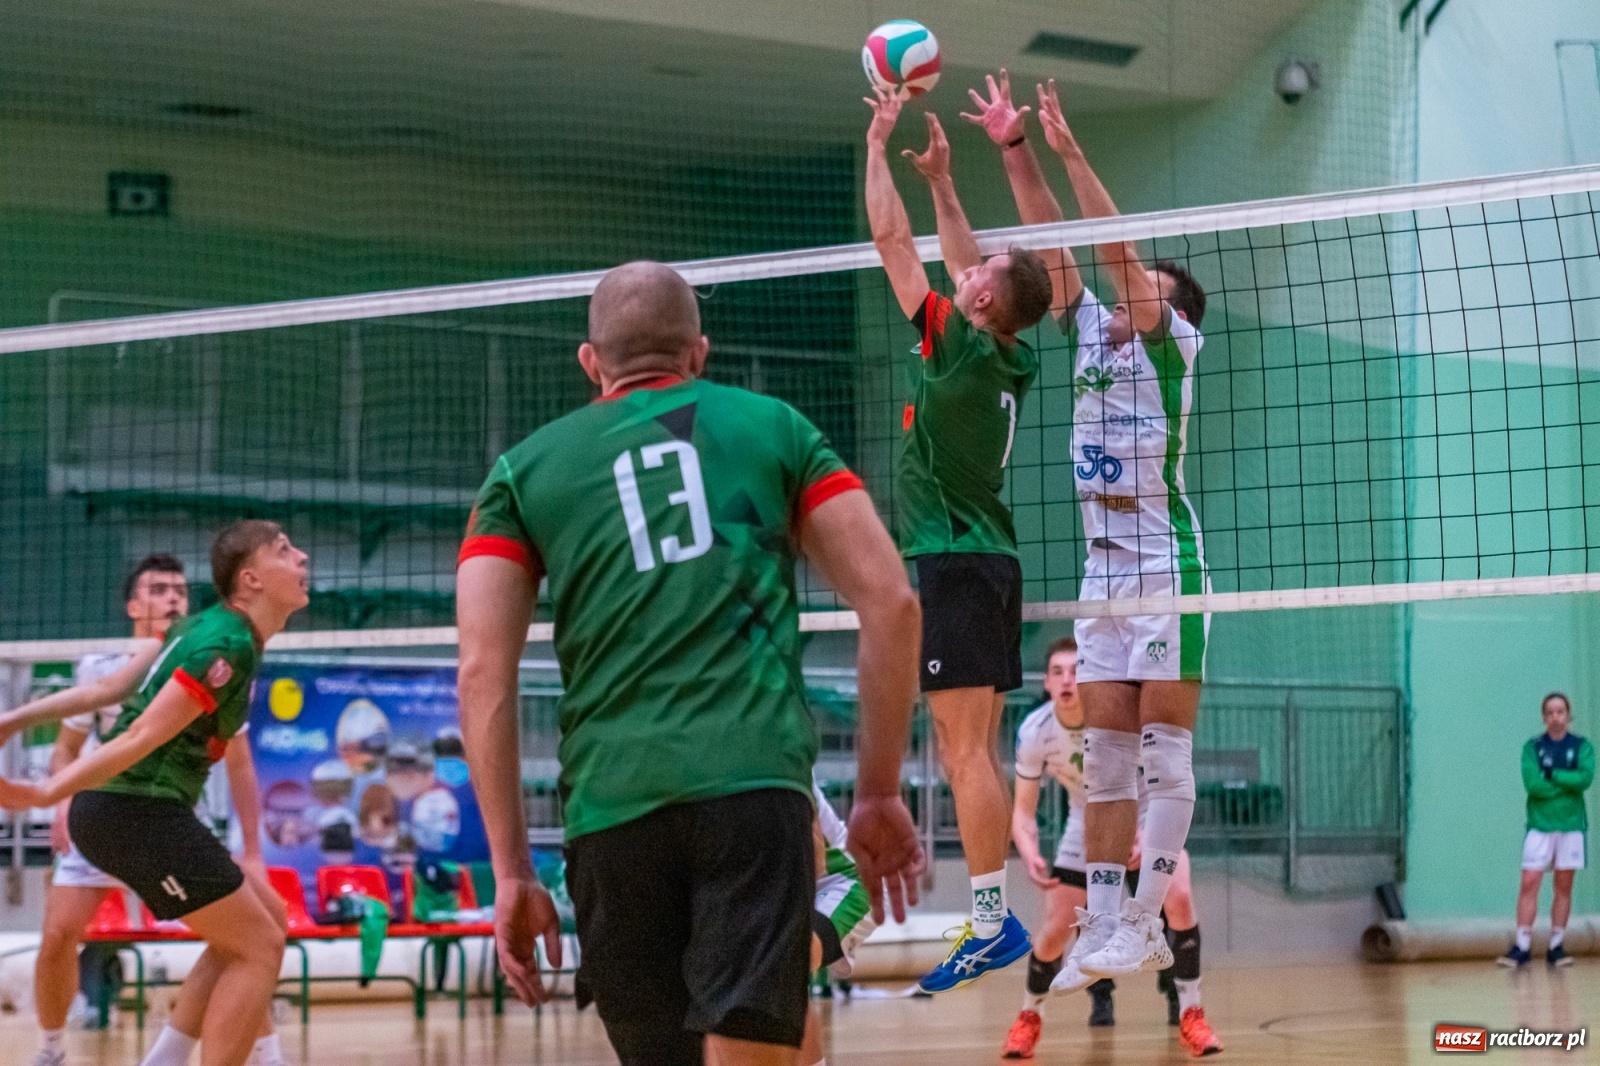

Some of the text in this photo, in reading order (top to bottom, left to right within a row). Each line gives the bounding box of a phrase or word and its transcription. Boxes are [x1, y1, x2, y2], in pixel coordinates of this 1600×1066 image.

[1001, 391, 1016, 468] 7
[613, 440, 714, 572] 13
[161, 875, 188, 901] 4
